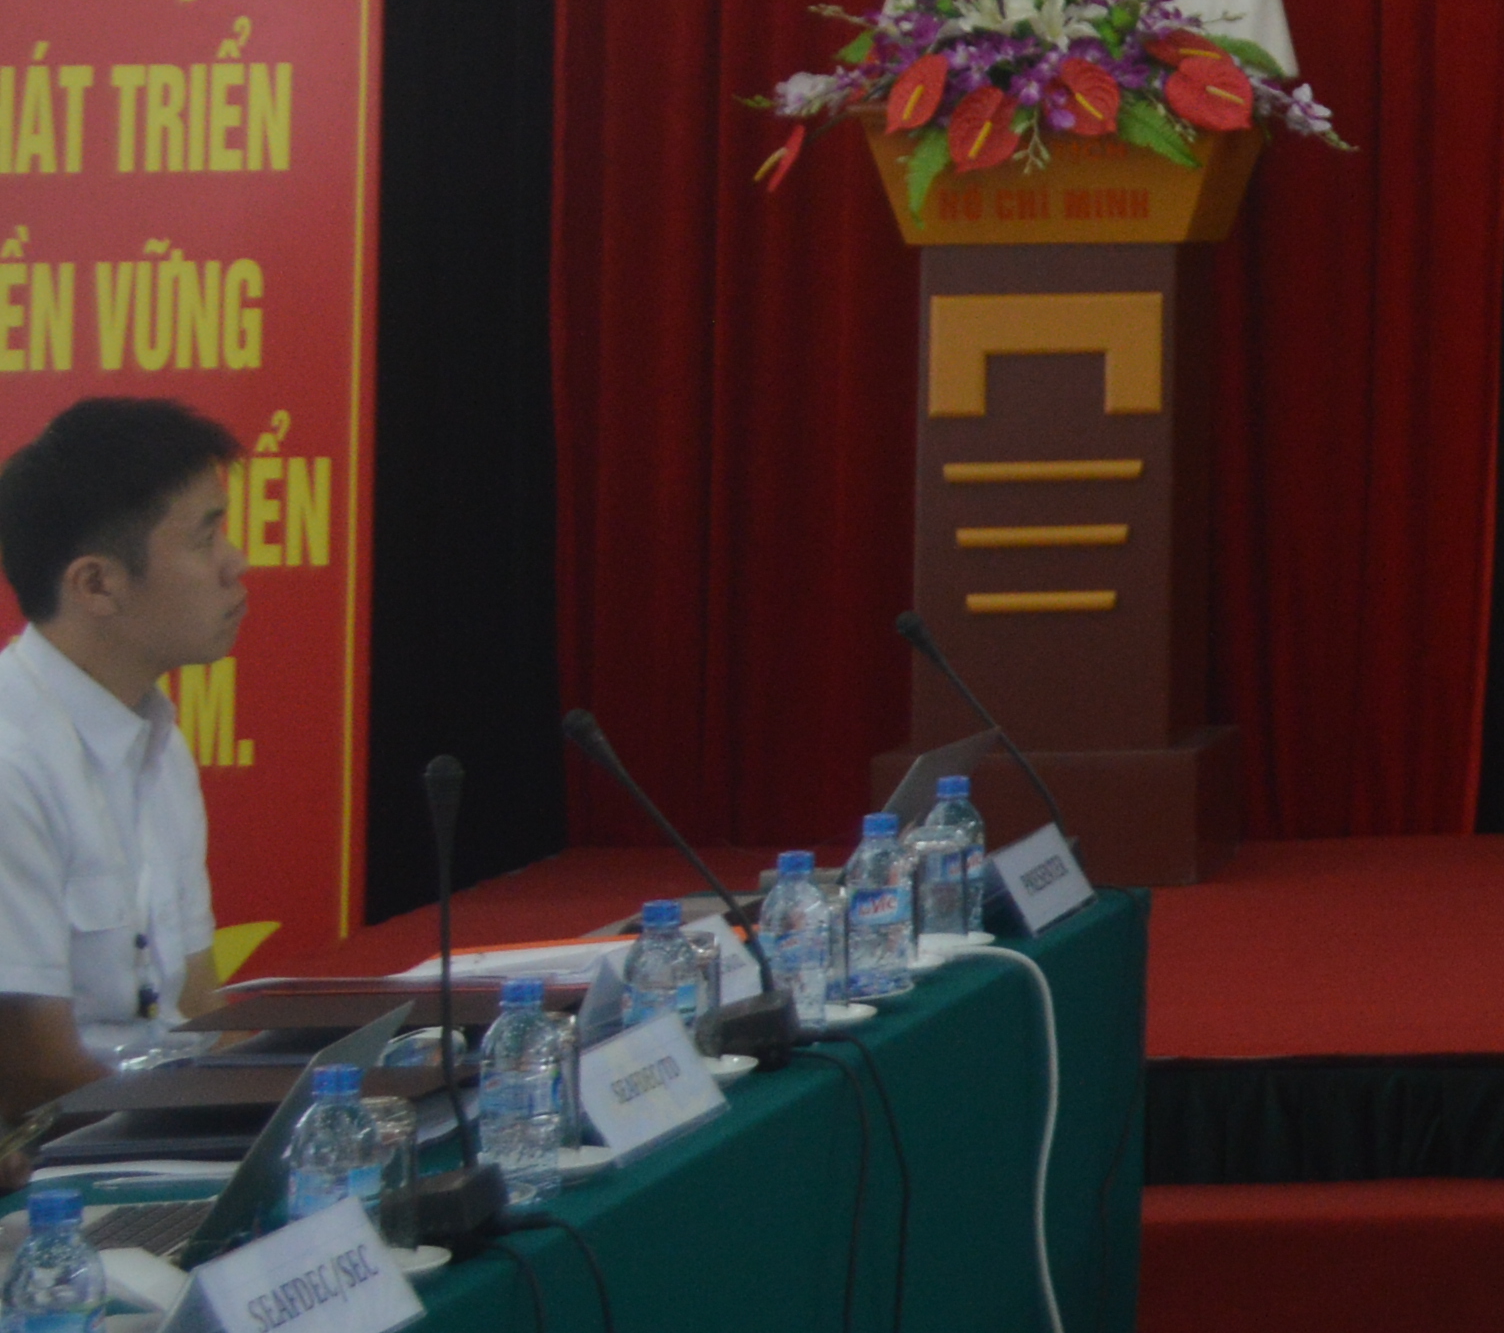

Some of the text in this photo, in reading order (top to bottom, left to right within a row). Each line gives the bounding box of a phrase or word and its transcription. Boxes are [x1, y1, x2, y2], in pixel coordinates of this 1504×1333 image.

[0, 17, 292, 173] ÁT TRIỂN
[1063, 189, 1149, 220] MINH
[0, 226, 263, 372] ỀN VỮNG
[228, 411, 331, 567] IỂN
[157, 657, 254, 766] M.
[248, 1244, 379, 1333] SEAFDEC/SEC
